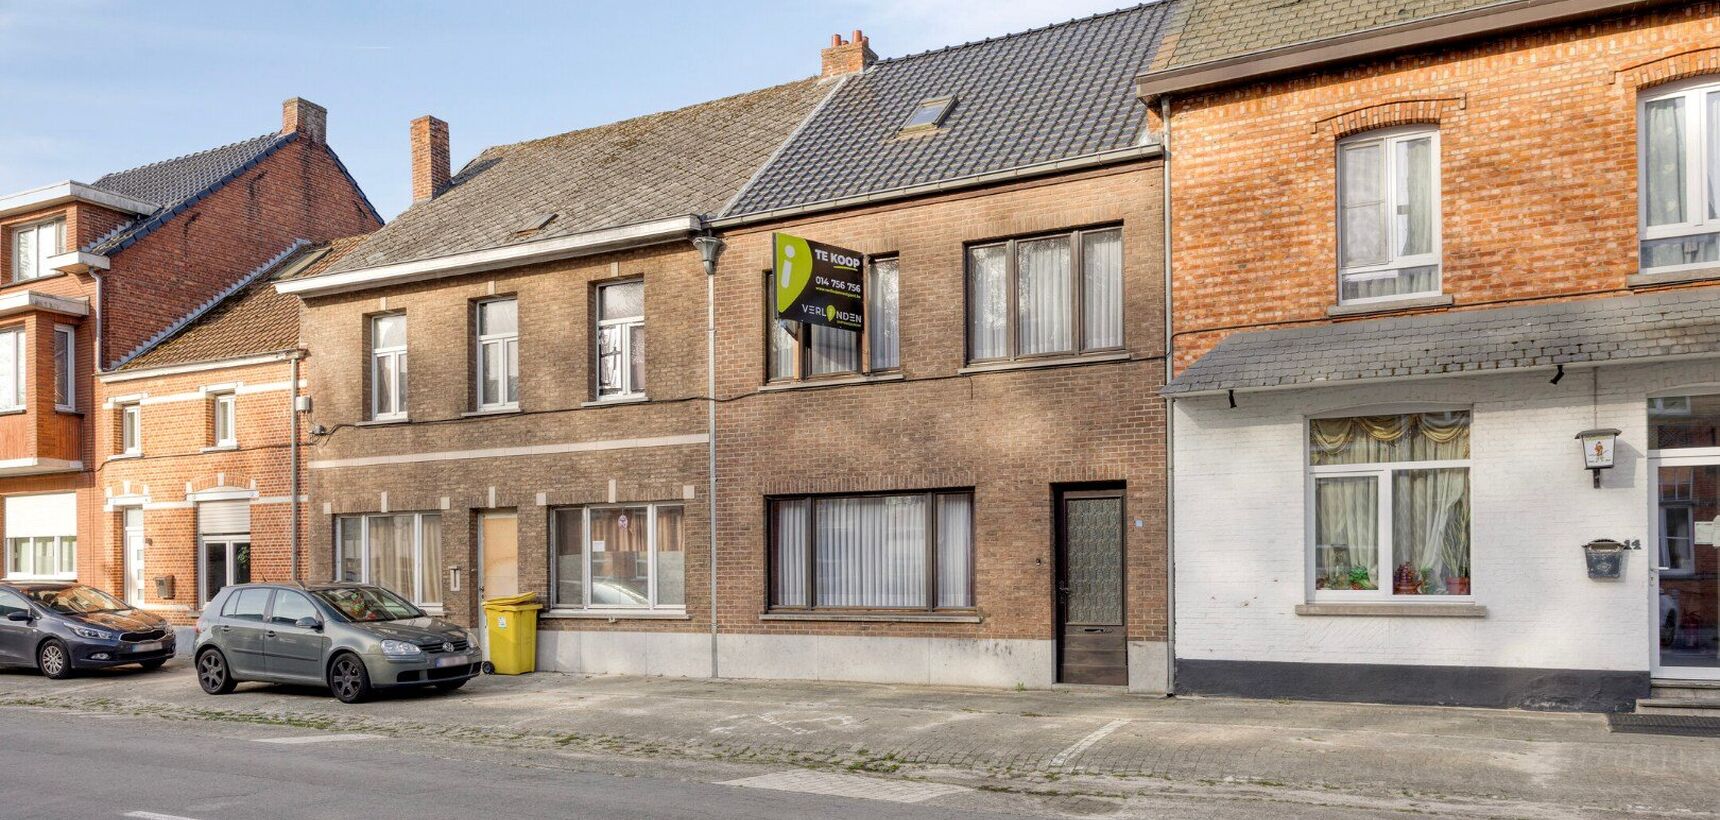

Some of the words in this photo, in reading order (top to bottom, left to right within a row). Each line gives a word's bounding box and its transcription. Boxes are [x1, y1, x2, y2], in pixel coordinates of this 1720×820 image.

[814, 249, 829, 262] TE
[830, 252, 861, 268] KOOP
[815, 276, 830, 286] 014
[831, 279, 846, 290] 756
[846, 282, 861, 293] 756
